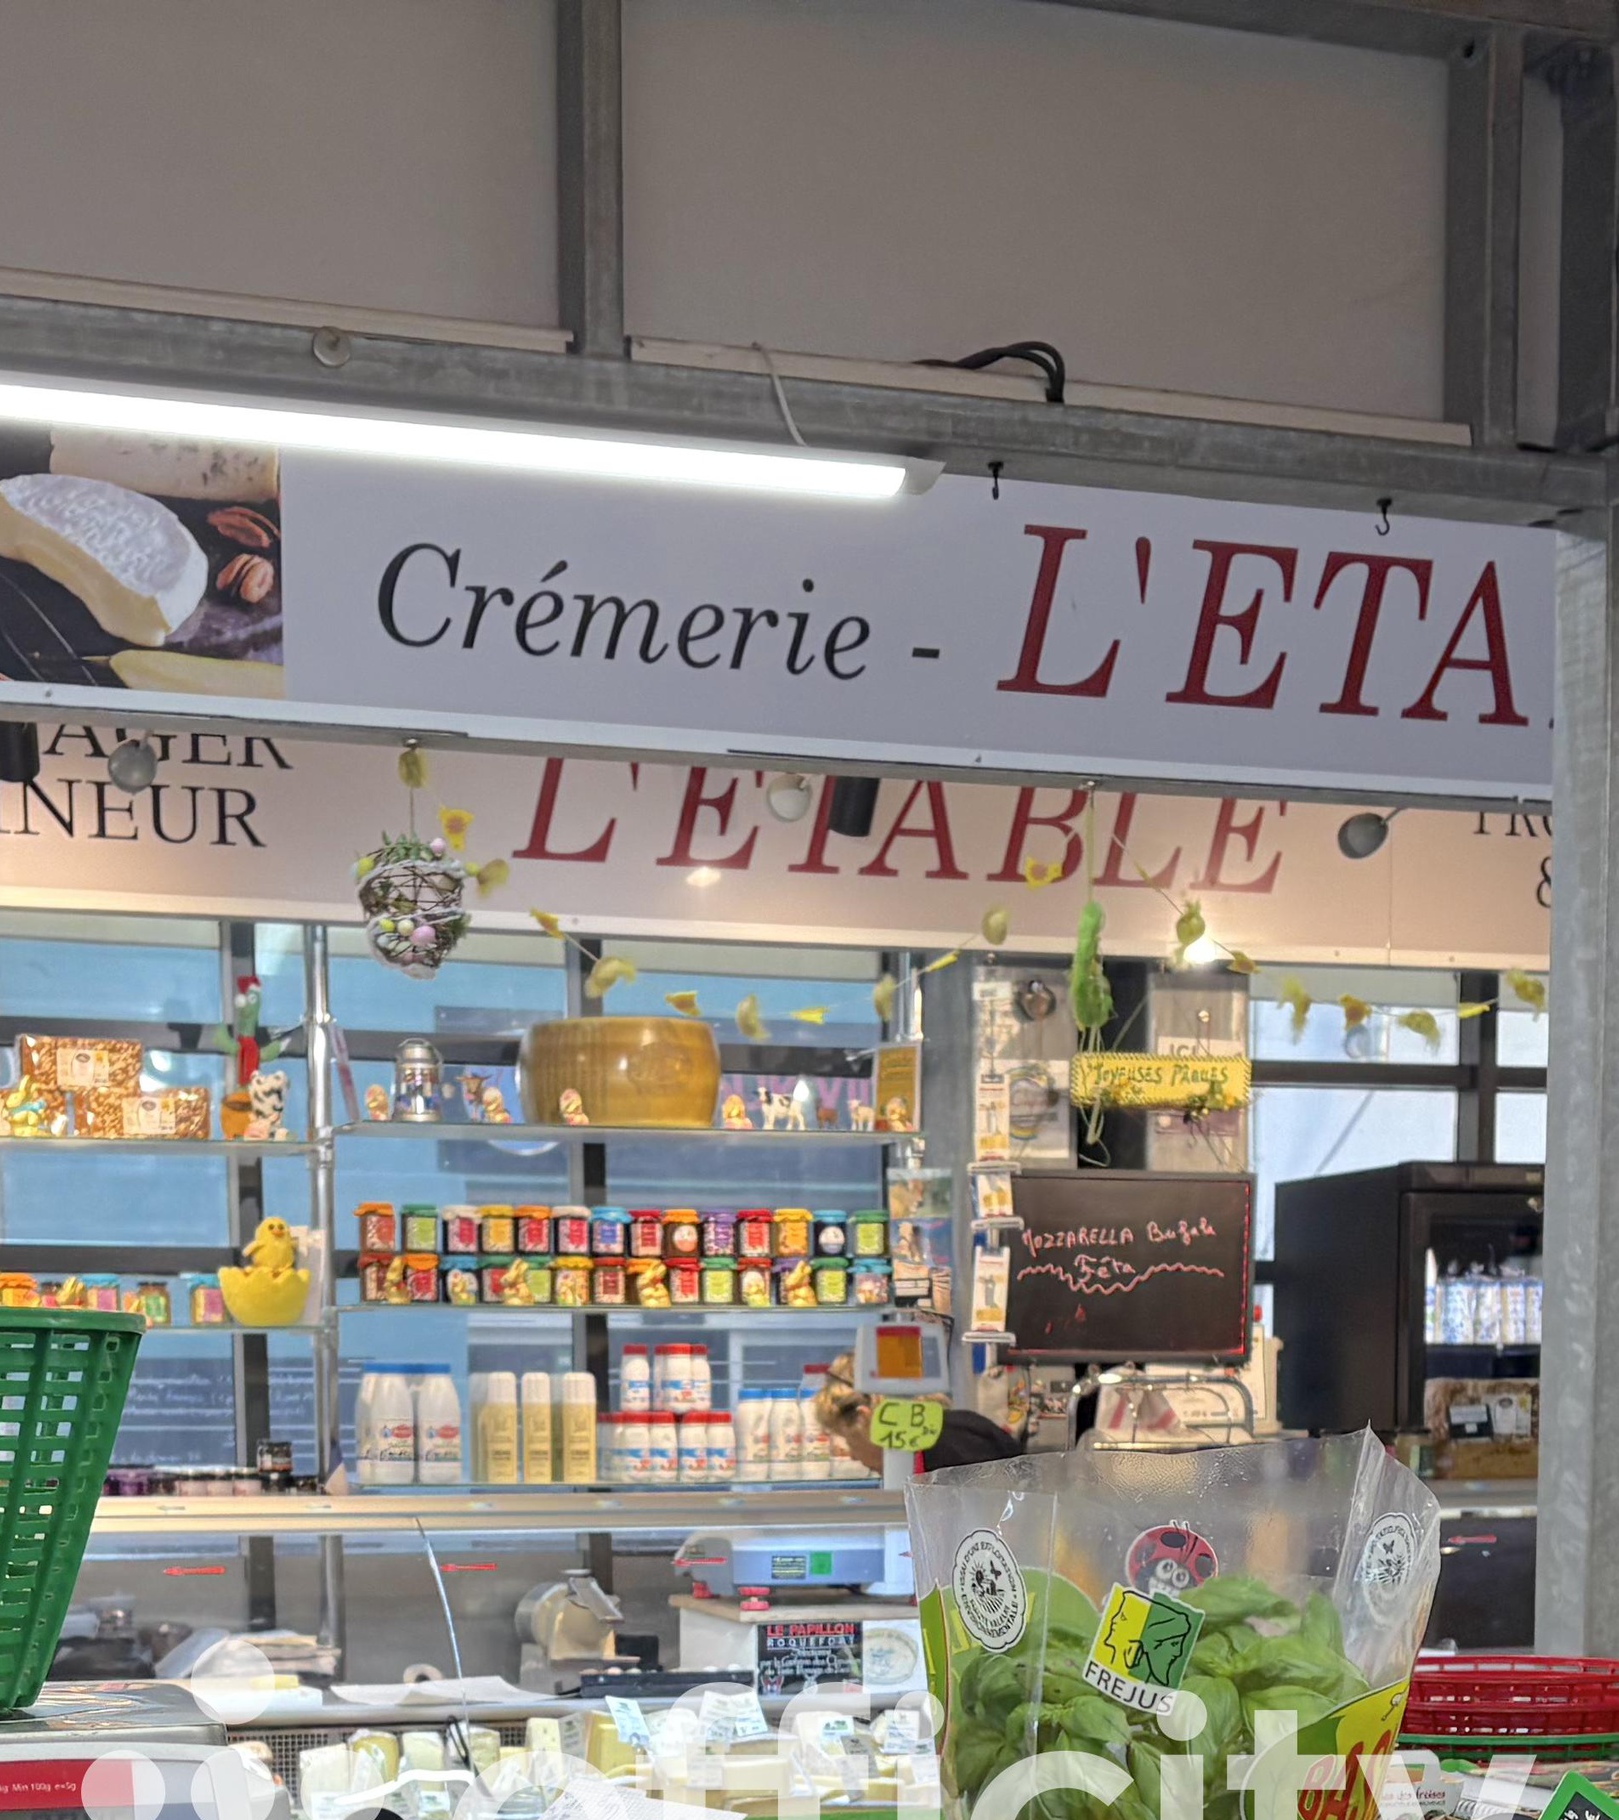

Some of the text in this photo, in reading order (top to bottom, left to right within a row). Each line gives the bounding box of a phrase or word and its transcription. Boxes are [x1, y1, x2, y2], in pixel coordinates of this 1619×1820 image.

[377, 541, 872, 681] Crémerie
[766, 1623, 855, 1636] LE PAPILLON
[1084, 1660, 1173, 1714] FREJUS
[11, 1783, 29, 1793] Min
